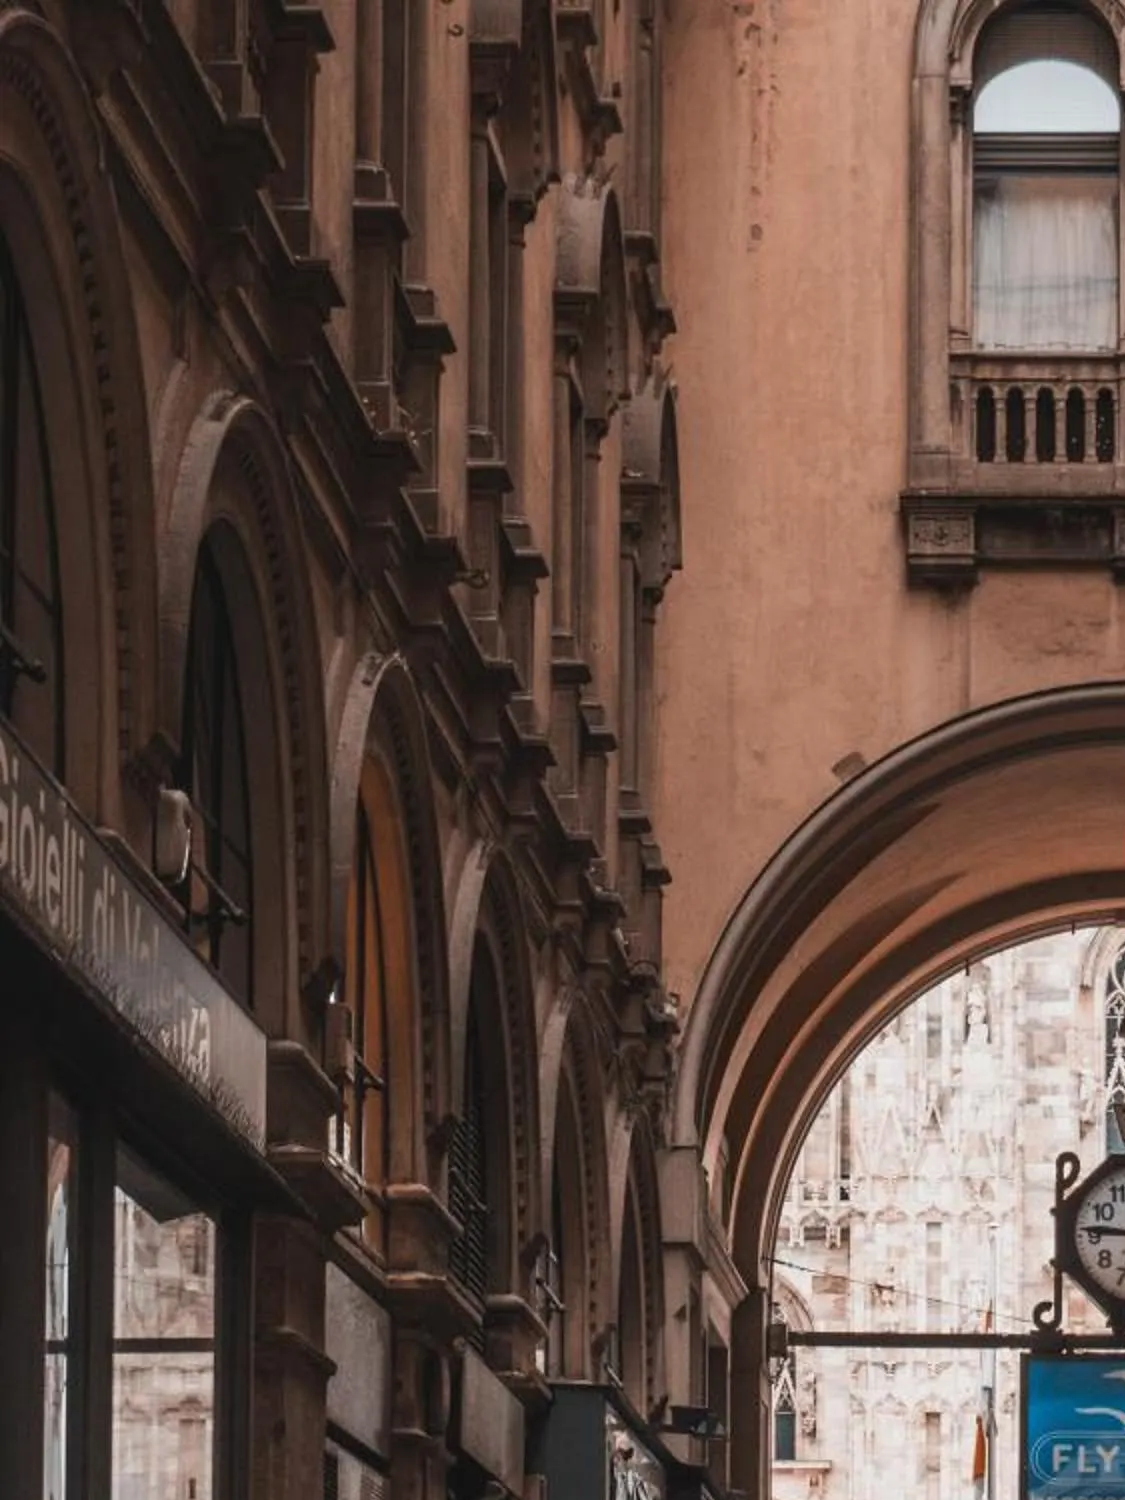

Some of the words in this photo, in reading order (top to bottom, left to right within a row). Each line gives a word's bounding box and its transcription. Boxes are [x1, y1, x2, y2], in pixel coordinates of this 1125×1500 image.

[1110, 1184, 1125, 1202] 11
[1094, 1202, 1115, 1221] 10
[1098, 1249, 1112, 1269] 8
[1052, 1444, 1120, 1473] FLY
